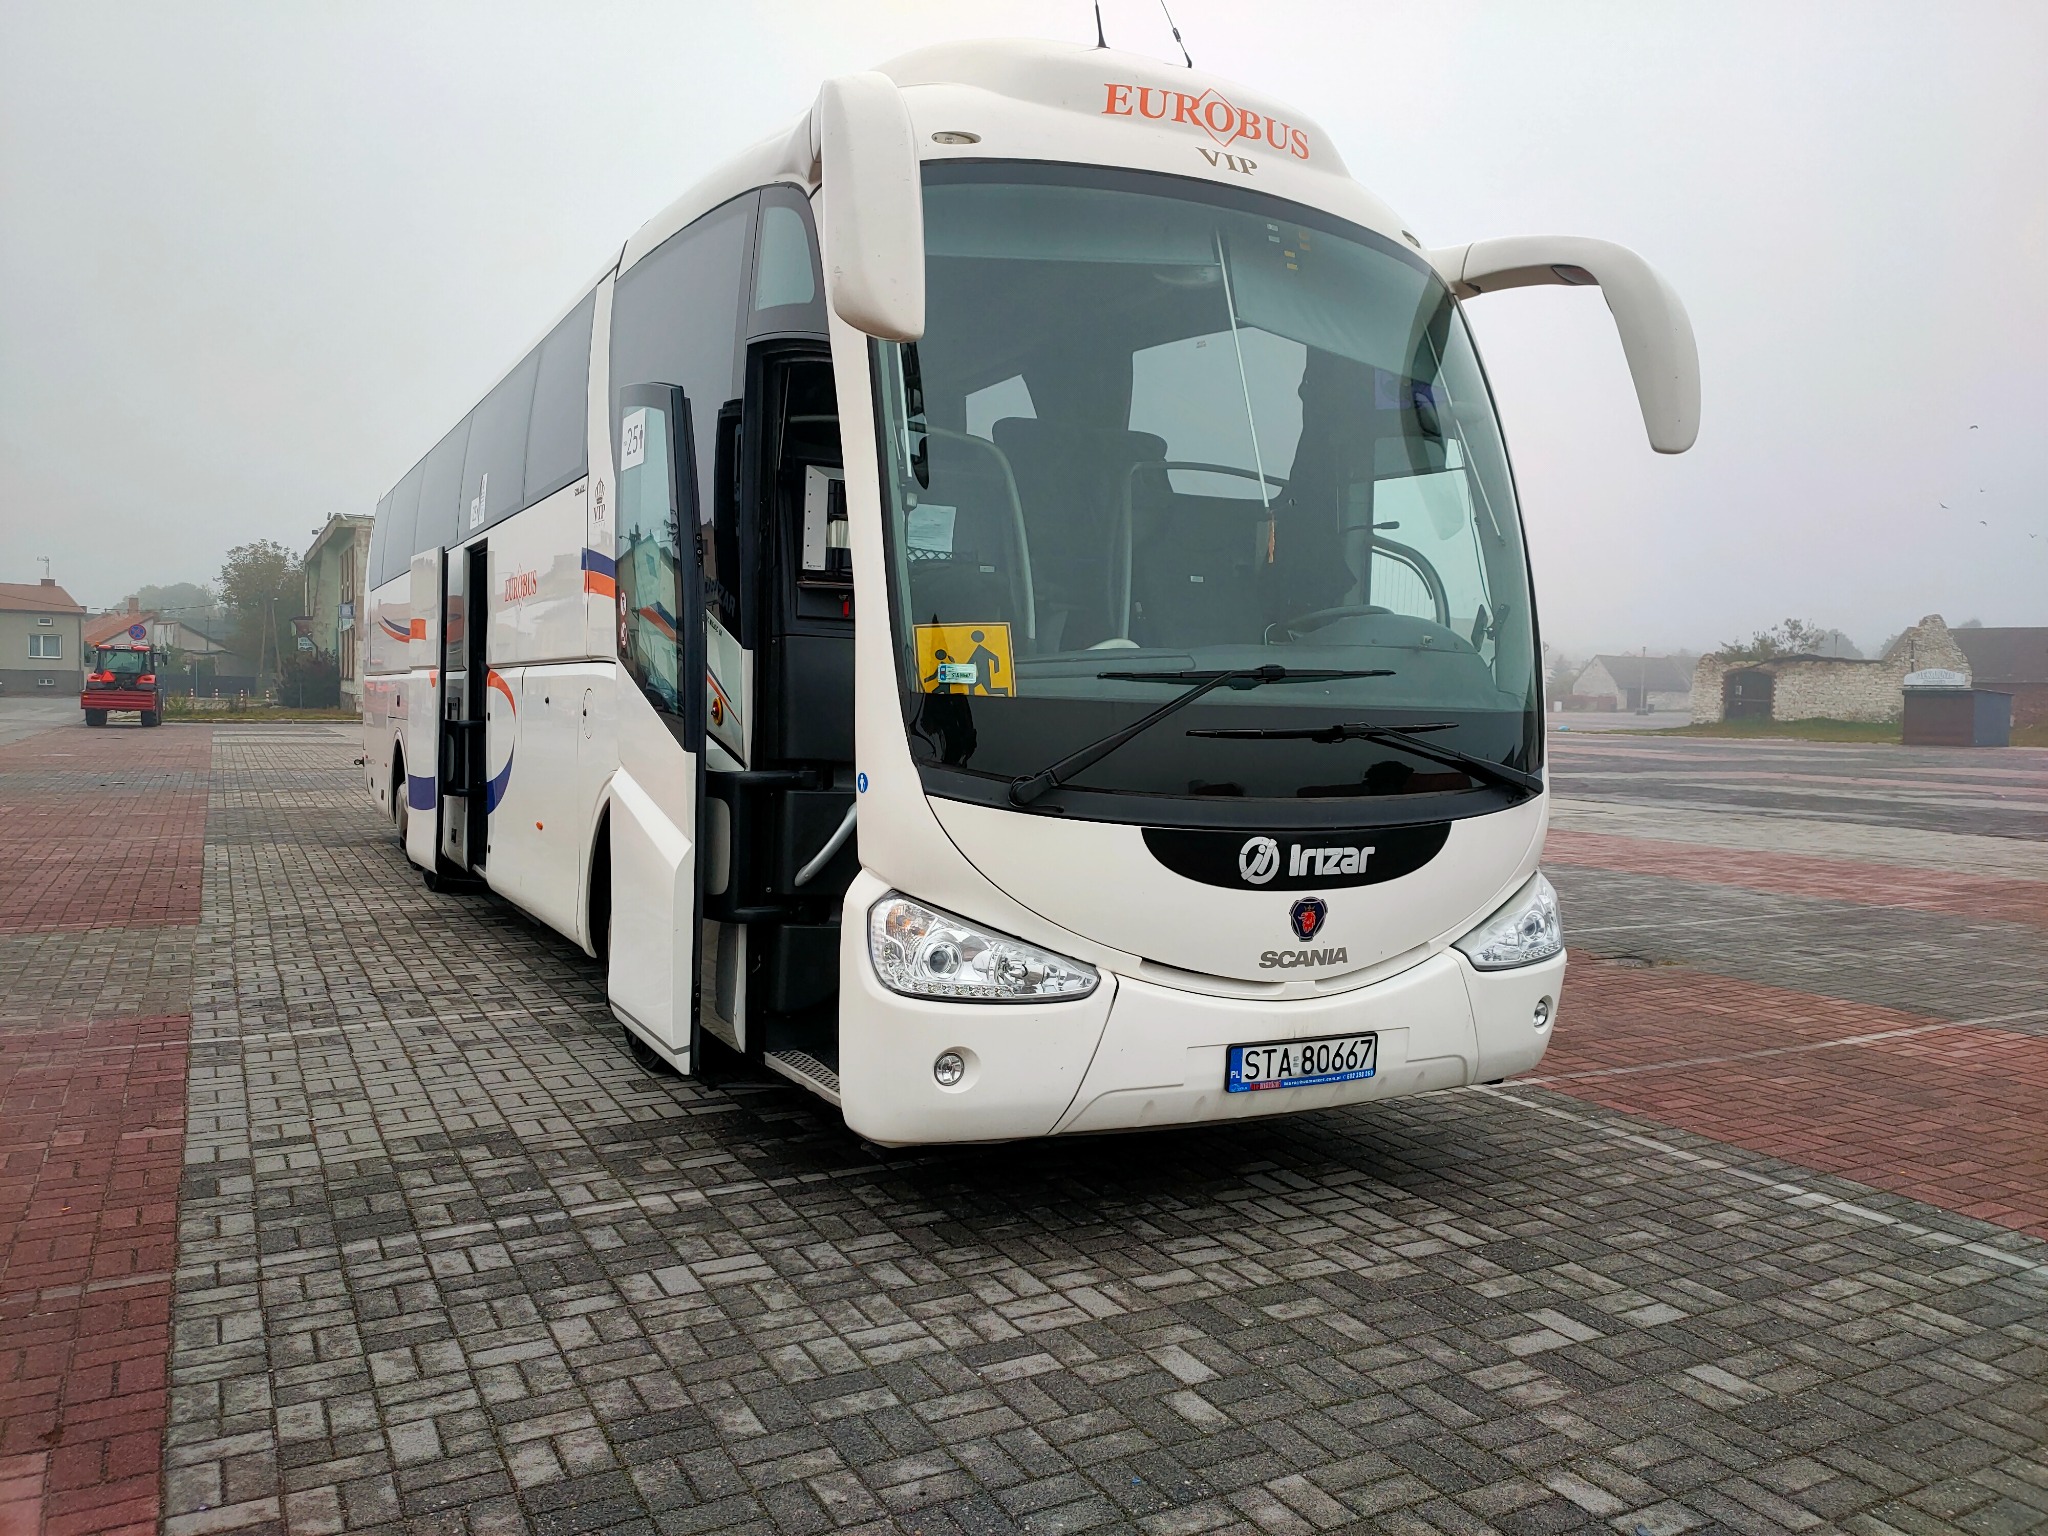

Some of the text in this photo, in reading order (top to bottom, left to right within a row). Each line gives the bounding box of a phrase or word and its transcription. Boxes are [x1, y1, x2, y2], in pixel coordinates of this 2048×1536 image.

[1101, 83, 1310, 160] EUROBUS
[1195, 146, 1258, 176] VIP
[593, 503, 606, 521] VIP
[504, 569, 537, 602] EUROBUS
[1258, 946, 1348, 969] SCANIA
[1244, 1038, 1374, 1080] STA 80667
[1230, 1070, 1241, 1079] PL
